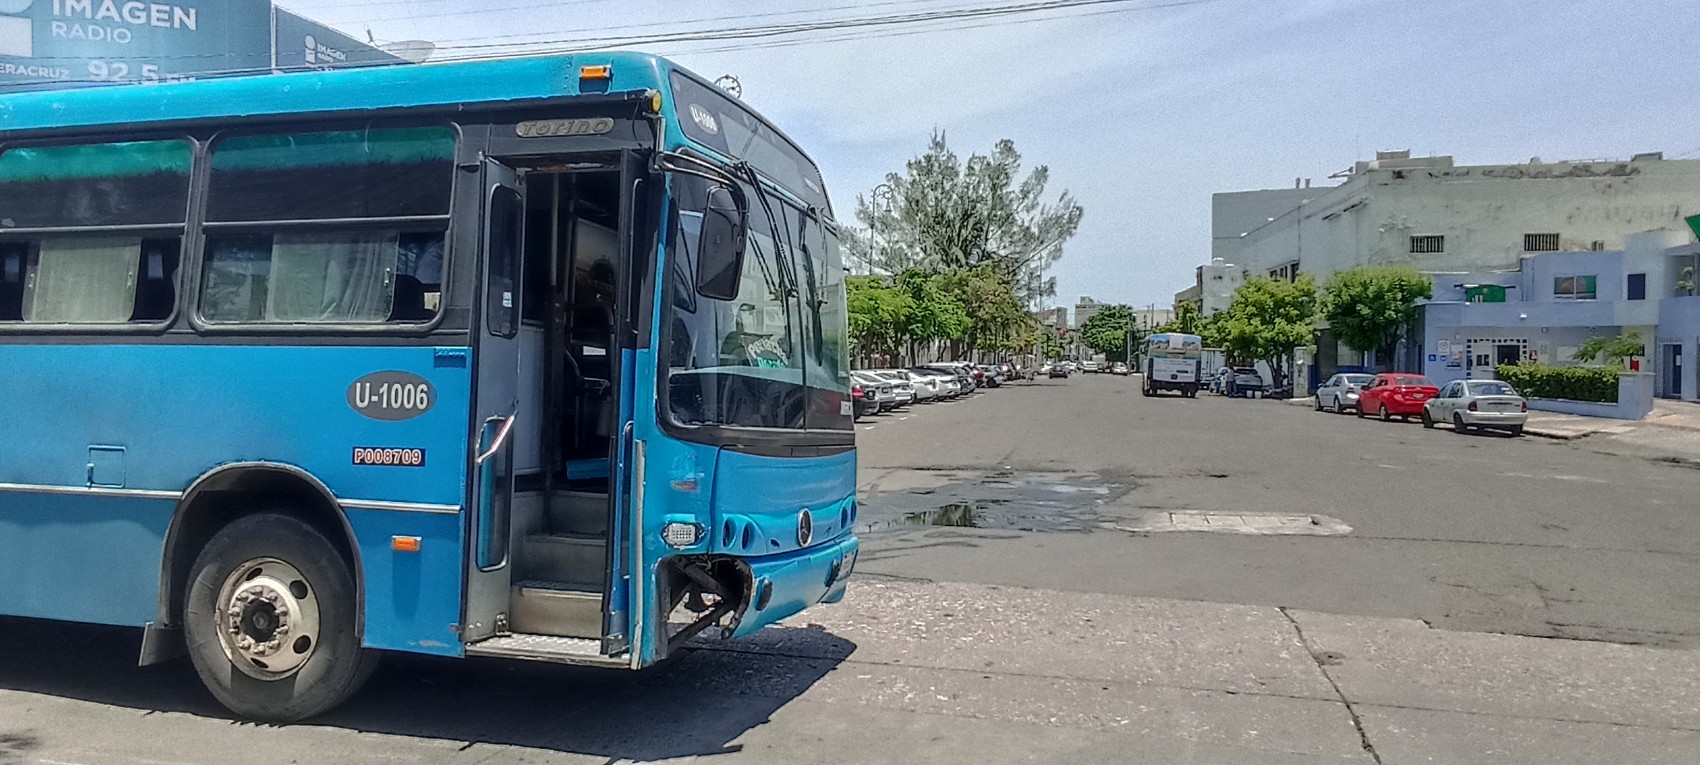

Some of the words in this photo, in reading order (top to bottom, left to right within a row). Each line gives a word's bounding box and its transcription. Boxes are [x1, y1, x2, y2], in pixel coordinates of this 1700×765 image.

[52, 0, 198, 31] IMAGEN
[51, 20, 132, 44] RADIO
[317, 42, 347, 62] IMAGEN
[355, 382, 429, 410] U-1006
[354, 448, 422, 465] P008709
